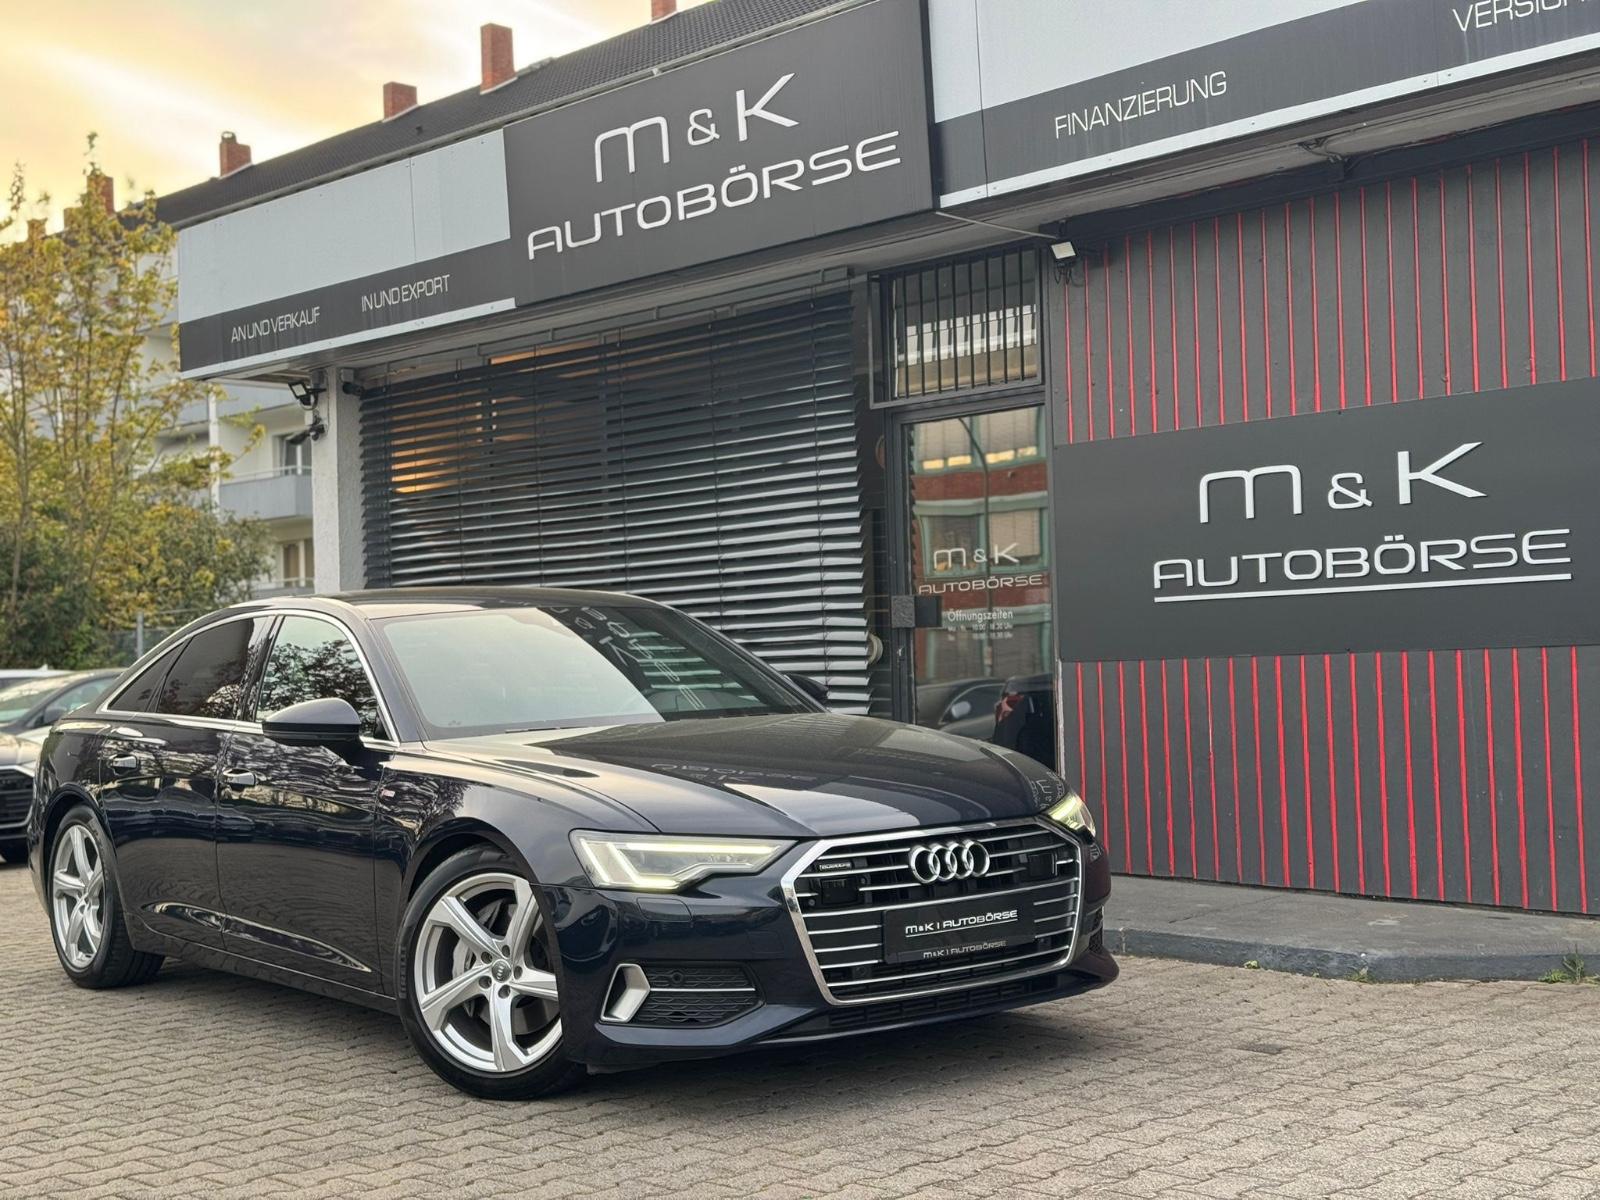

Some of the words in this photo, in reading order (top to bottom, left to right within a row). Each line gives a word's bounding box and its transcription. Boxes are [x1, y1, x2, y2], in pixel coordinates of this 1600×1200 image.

[1452, 0, 1584, 32] VERSI
[687, 108, 720, 146] &
[736, 72, 799, 142] K
[1054, 70, 1227, 139] FINANZIERUNG
[527, 130, 901, 260] AUTOBÖRSE
[401, 274, 450, 302] EXPORT
[270, 306, 320, 334] VERKAUF
[1328, 472, 1373, 510] &
[1397, 441, 1488, 505] K
[973, 548, 987, 563] &
[994, 542, 1020, 565] K
[1153, 528, 1571, 589] AUTOBÖRSE
[918, 574, 1043, 595] AUTOBÖRSE
[947, 608, 1014, 623] Öffnungszeiten
[943, 909, 1018, 929] AUTOBÖRSE
[950, 940, 1007, 955] AUTOBÖRSE
